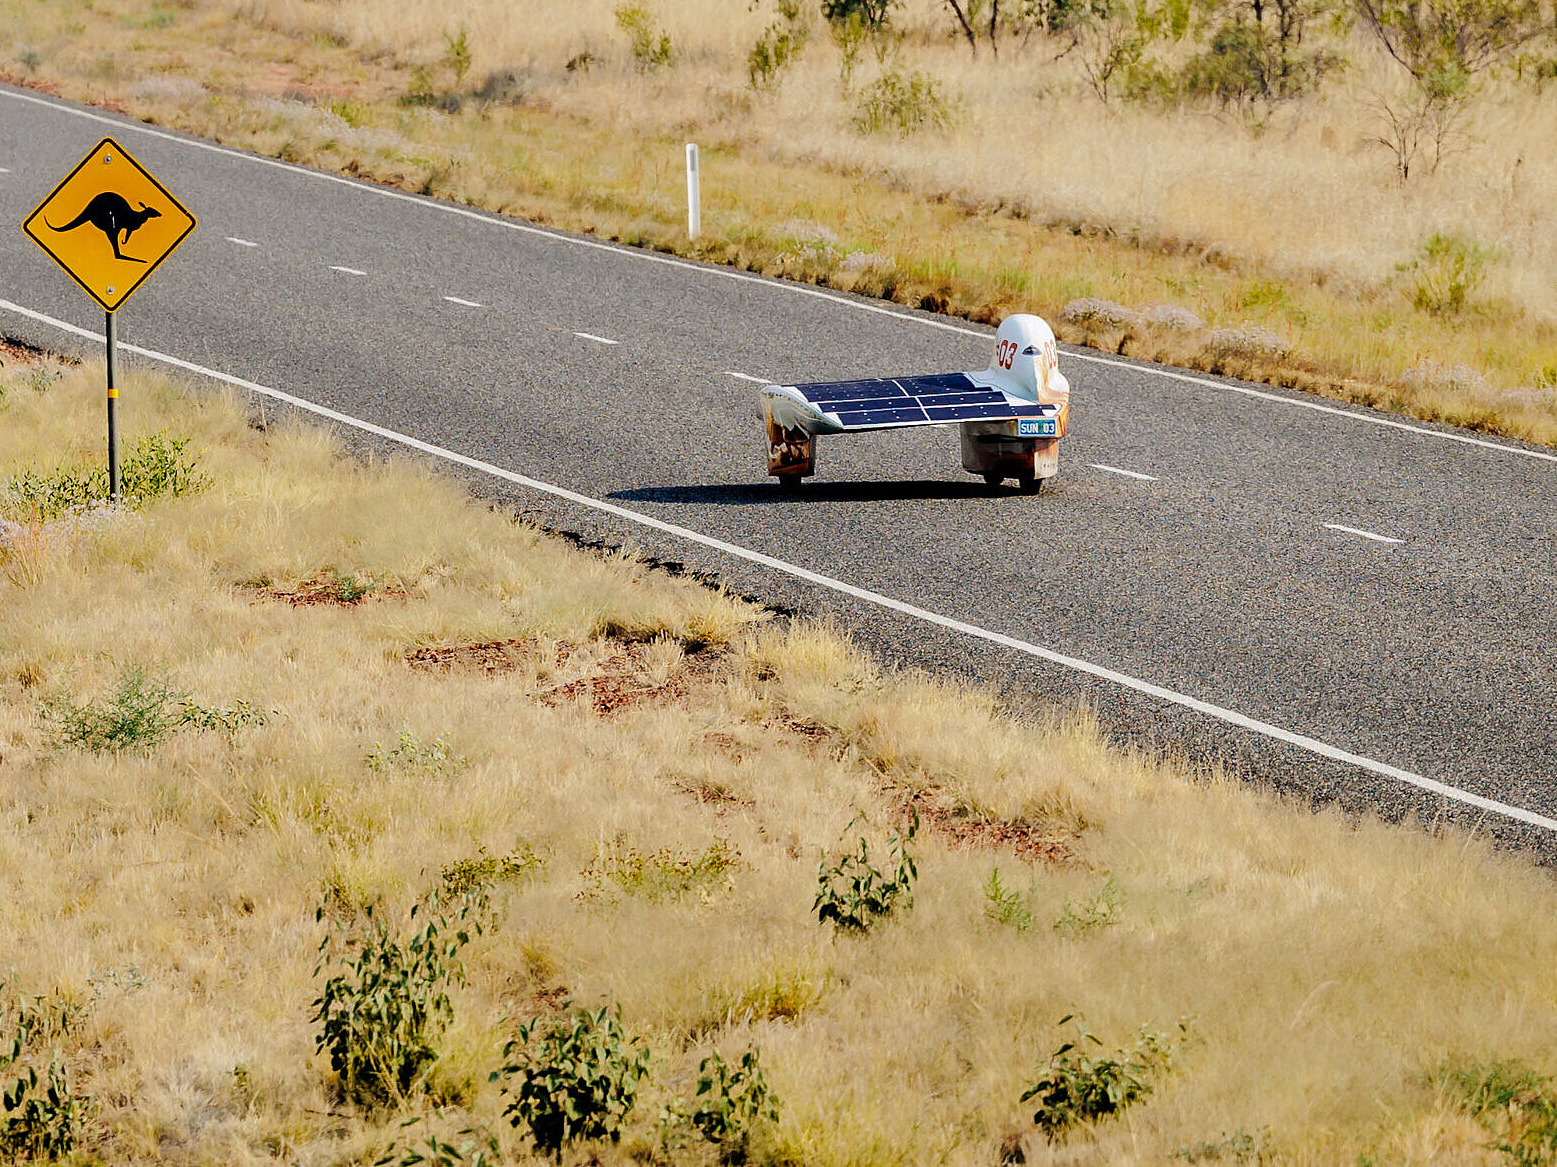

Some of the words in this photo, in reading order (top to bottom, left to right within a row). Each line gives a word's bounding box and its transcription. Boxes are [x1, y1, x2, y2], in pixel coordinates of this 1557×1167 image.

[999, 339, 1018, 370] 03
[1021, 423, 1038, 433] SUN
[1043, 423, 1054, 433] 03
